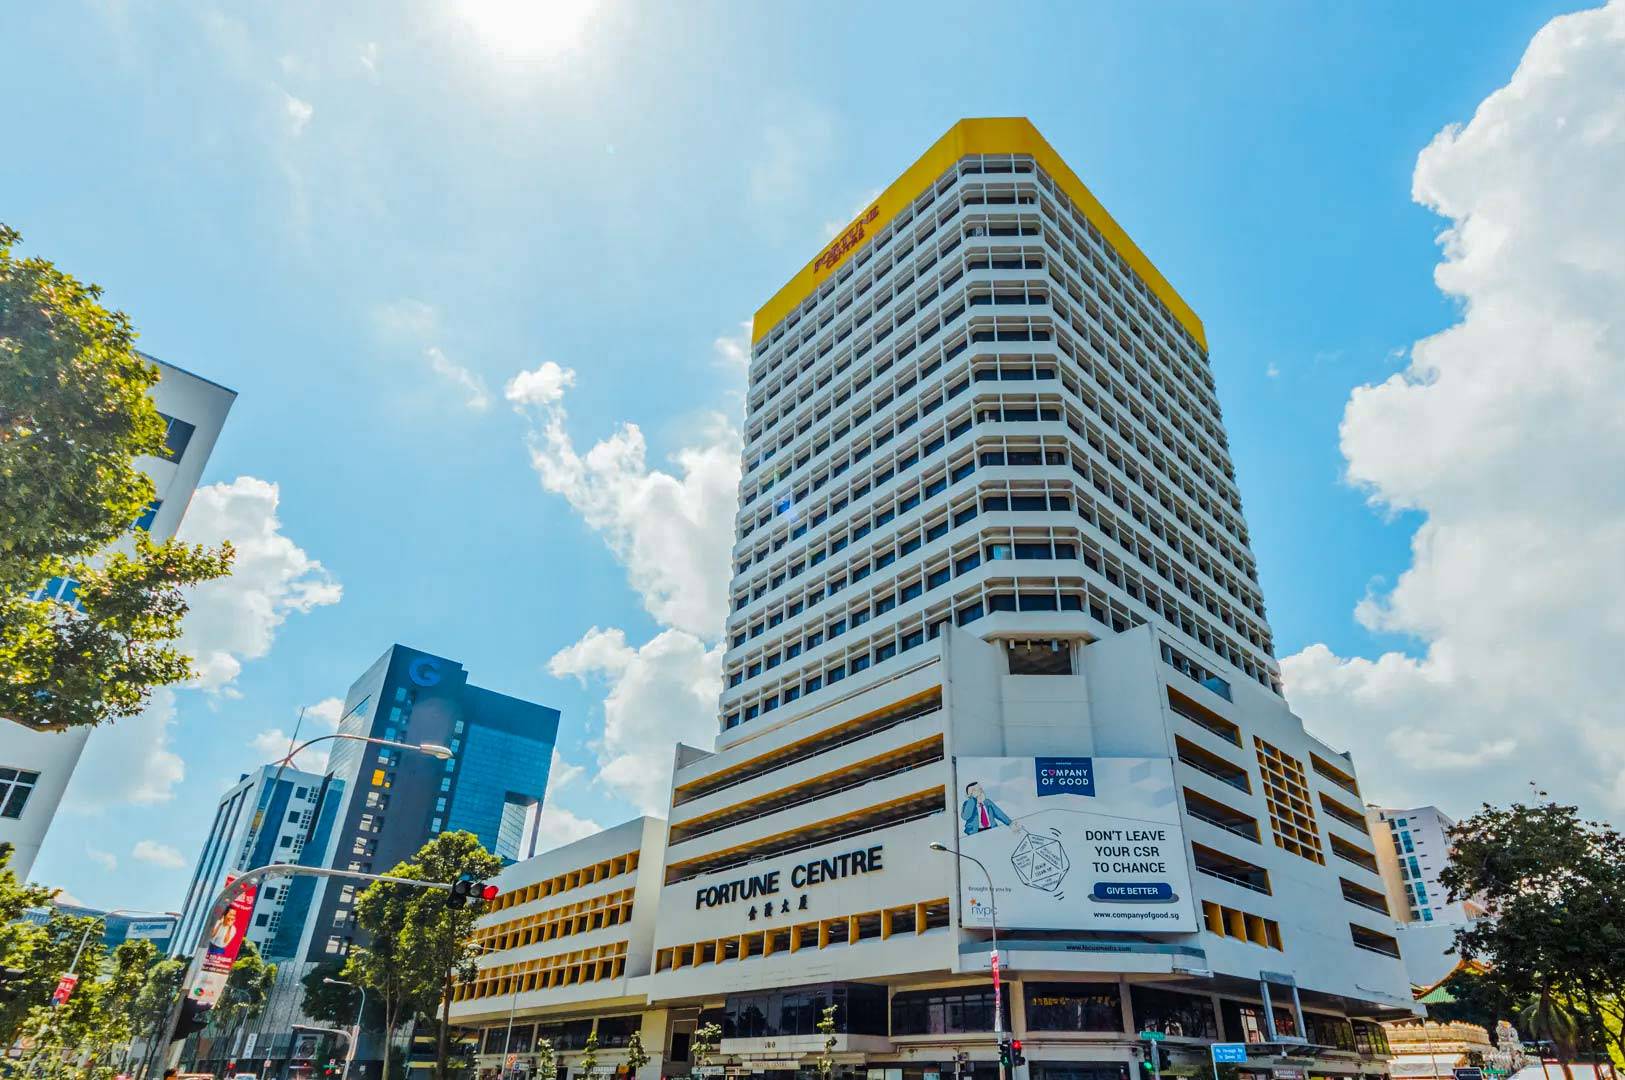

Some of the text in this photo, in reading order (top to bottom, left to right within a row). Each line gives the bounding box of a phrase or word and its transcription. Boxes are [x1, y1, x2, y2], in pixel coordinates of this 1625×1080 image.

[814, 205, 879, 273] FORTUNE
[1041, 769, 1088, 777] COMPANY
[1085, 830, 1166, 841] DON'T LEAVE
[1094, 846, 1160, 857] YOUR CSR
[1092, 862, 1166, 873] TO CHANCE
[695, 845, 883, 910] FORTUNE CENTRE
[1127, 887, 1158, 895] BETTER
[1093, 911, 1180, 920] www.companyofgood.sg
